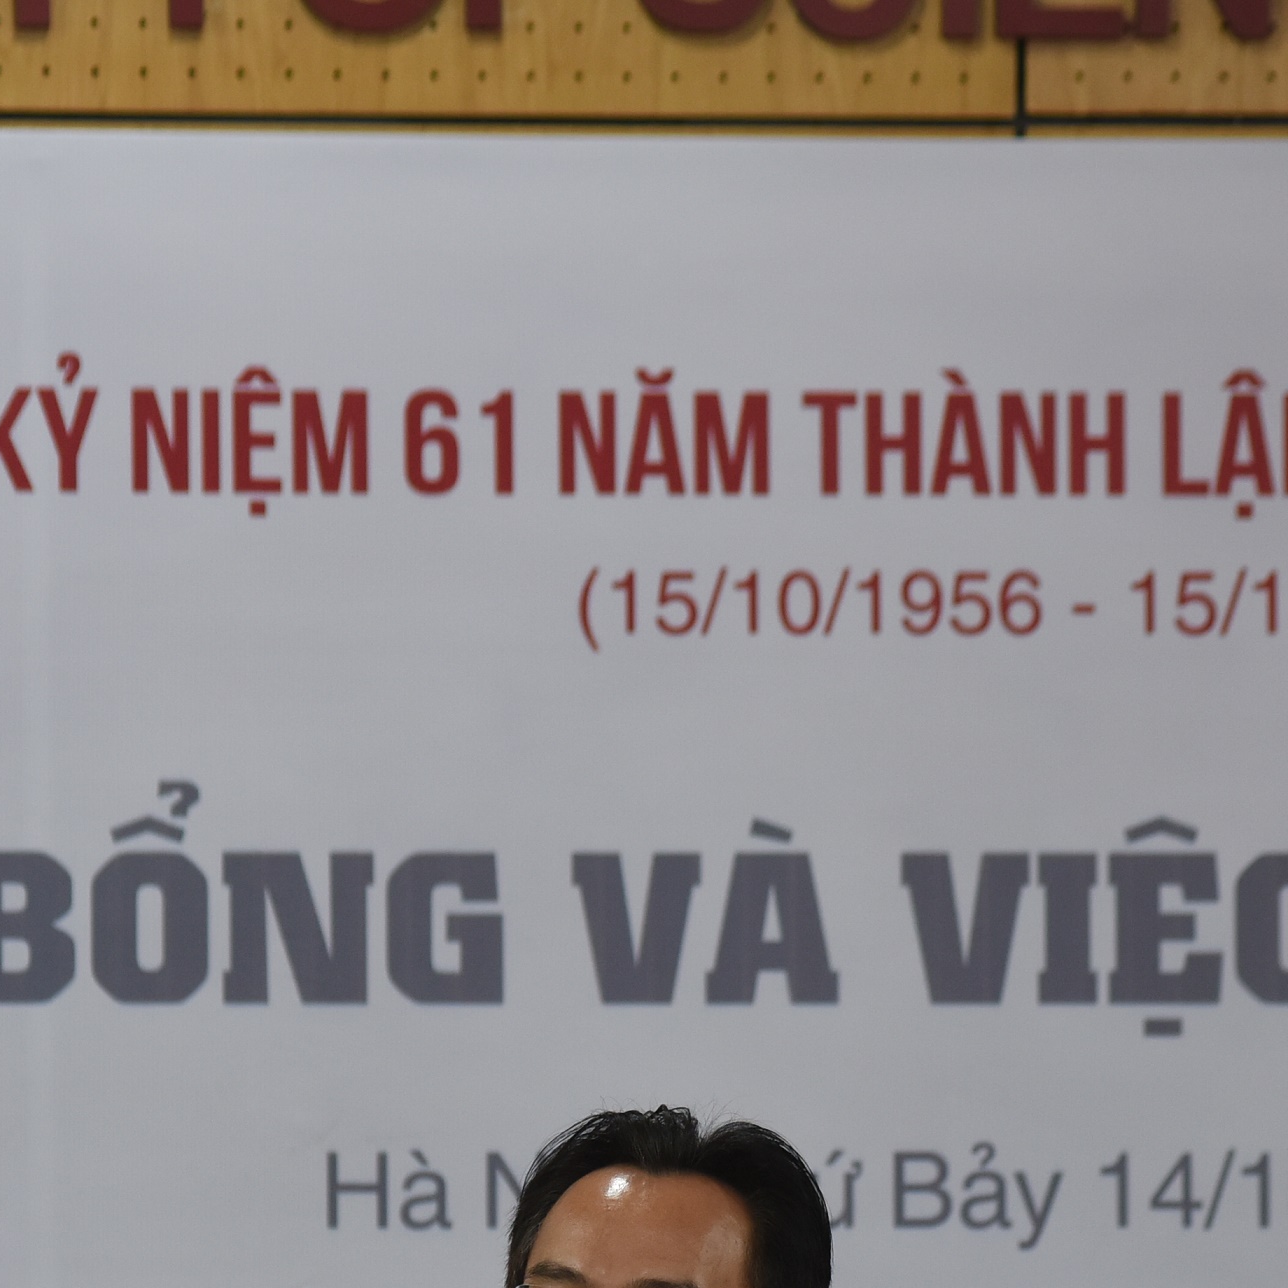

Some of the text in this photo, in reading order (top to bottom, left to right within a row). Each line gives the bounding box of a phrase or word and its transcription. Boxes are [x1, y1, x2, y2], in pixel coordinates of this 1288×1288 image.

[131, 365, 369, 517] NIỆM
[404, 388, 514, 496] 61
[558, 368, 770, 497] NĂM
[801, 368, 1126, 497] THÀNH
[578, 566, 1043, 652] (15/10/1956
[1071, 602, 1097, 616] -
[571, 817, 841, 1008] VÀ
[326, 1149, 453, 1231] Hà
[893, 1140, 1064, 1251] Bảy
